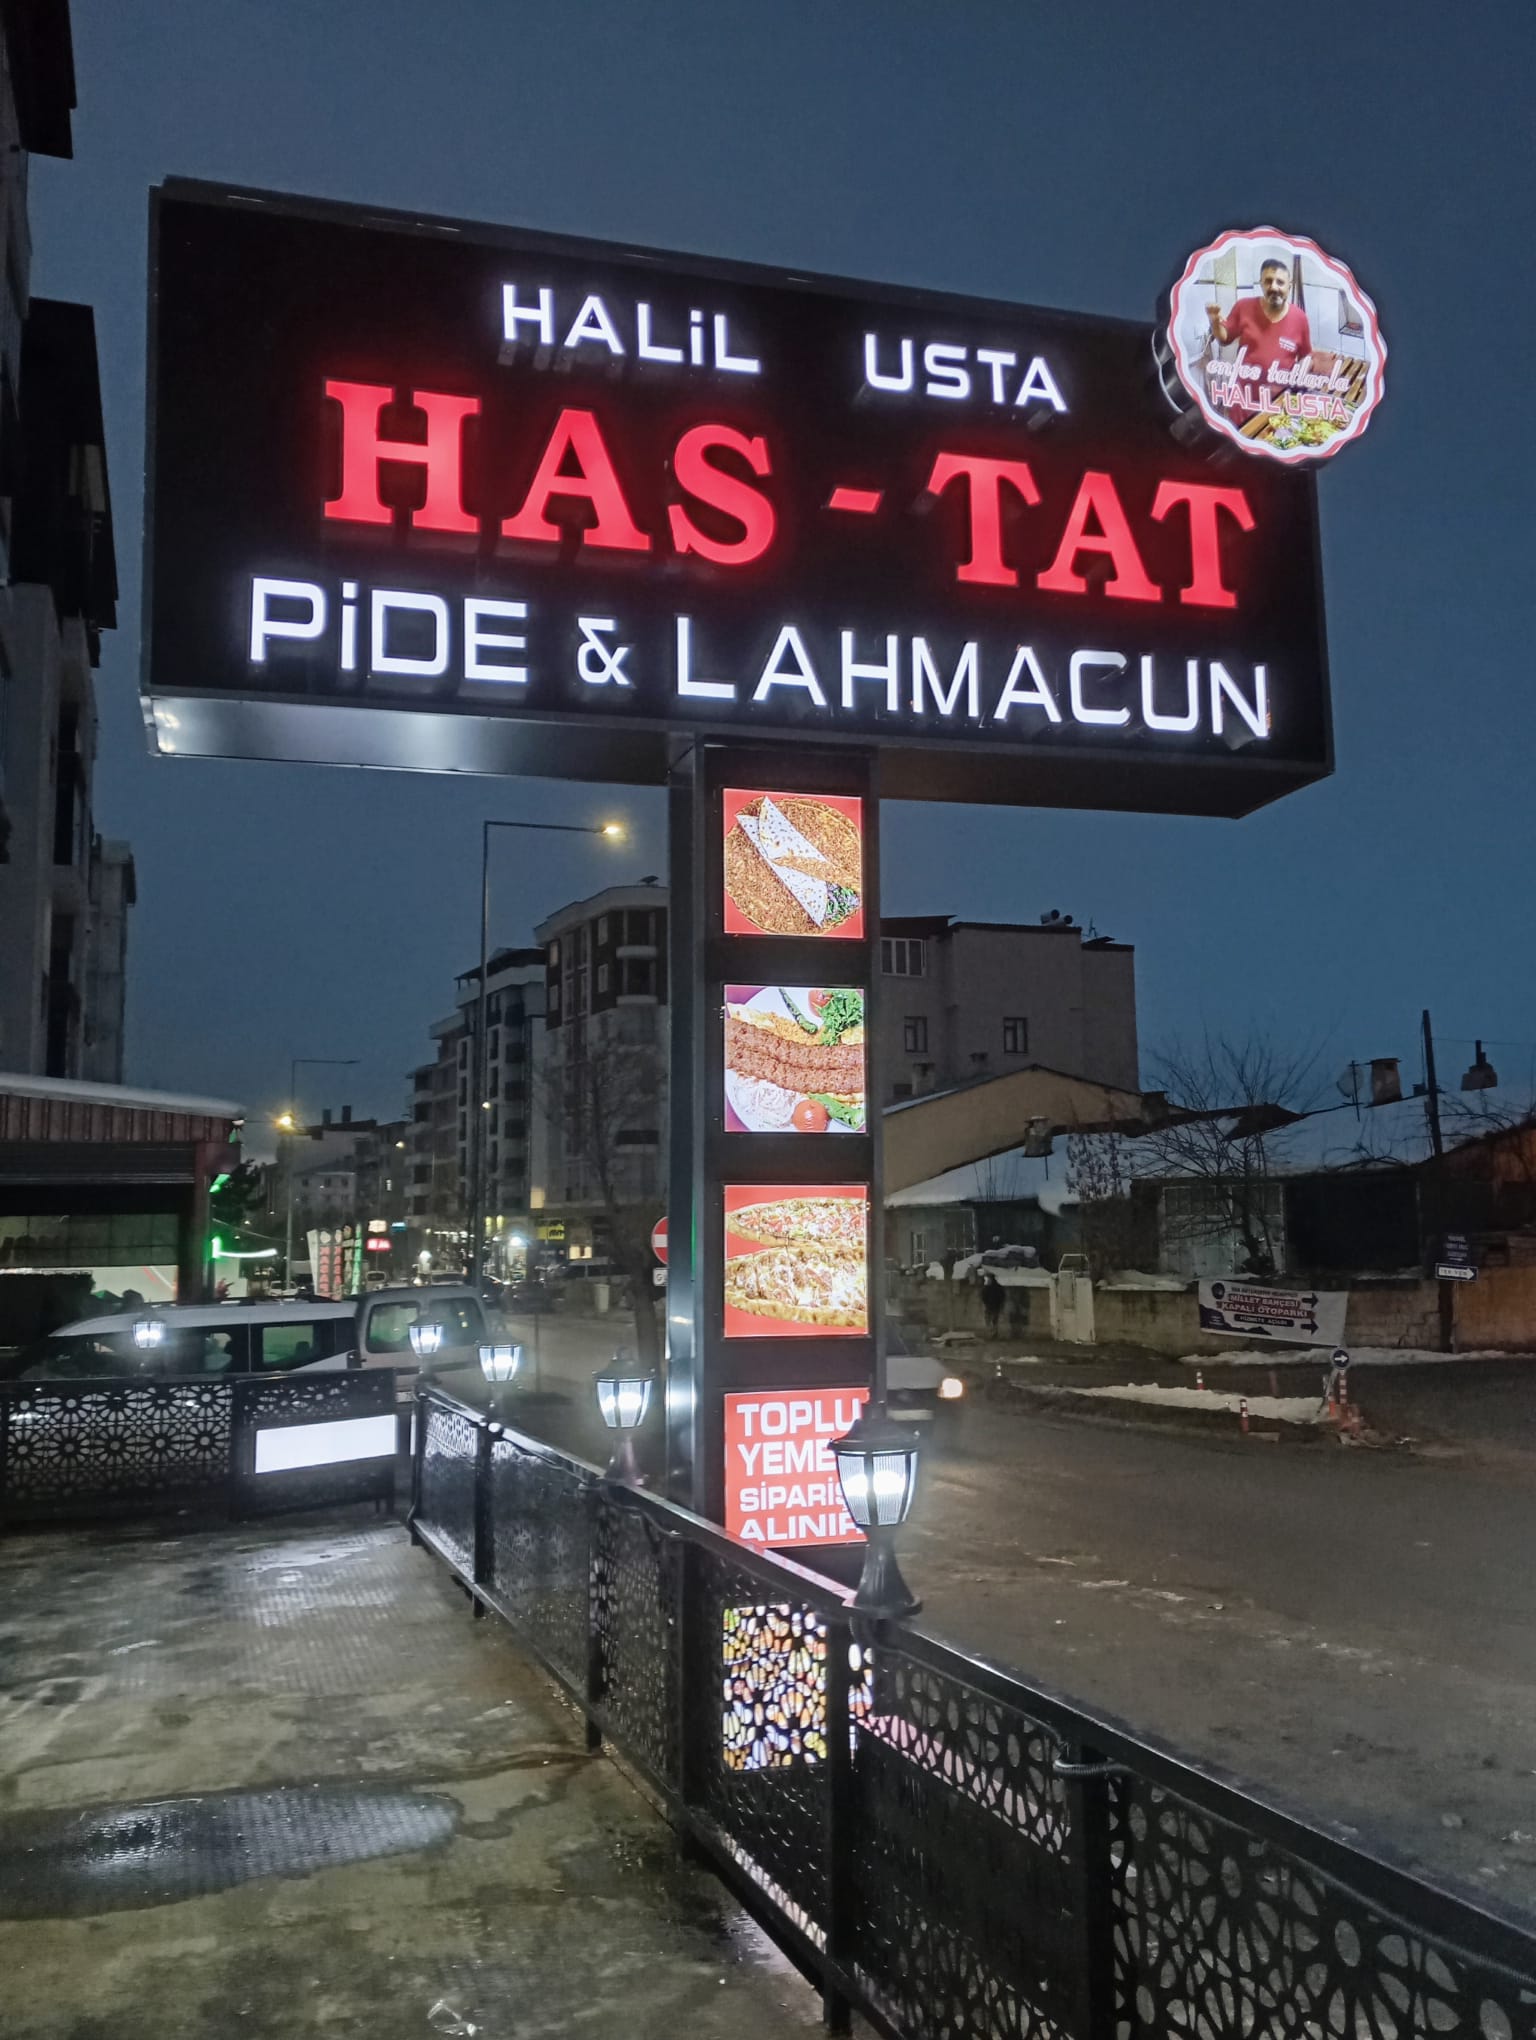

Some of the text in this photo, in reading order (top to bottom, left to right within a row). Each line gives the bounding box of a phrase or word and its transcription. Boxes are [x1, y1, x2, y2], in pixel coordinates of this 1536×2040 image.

[865, 333, 1067, 411] USTA
[1206, 345, 1350, 392] enfes tatlarla
[1284, 390, 1349, 423] USTA
[323, 379, 776, 565] HAS
[927, 452, 1256, 608] TAT
[577, 617, 630, 685] &
[676, 616, 1268, 737] LAHMACUN
[736, 1398, 862, 1437] TOPLU
[737, 1438, 838, 1476] YEME
